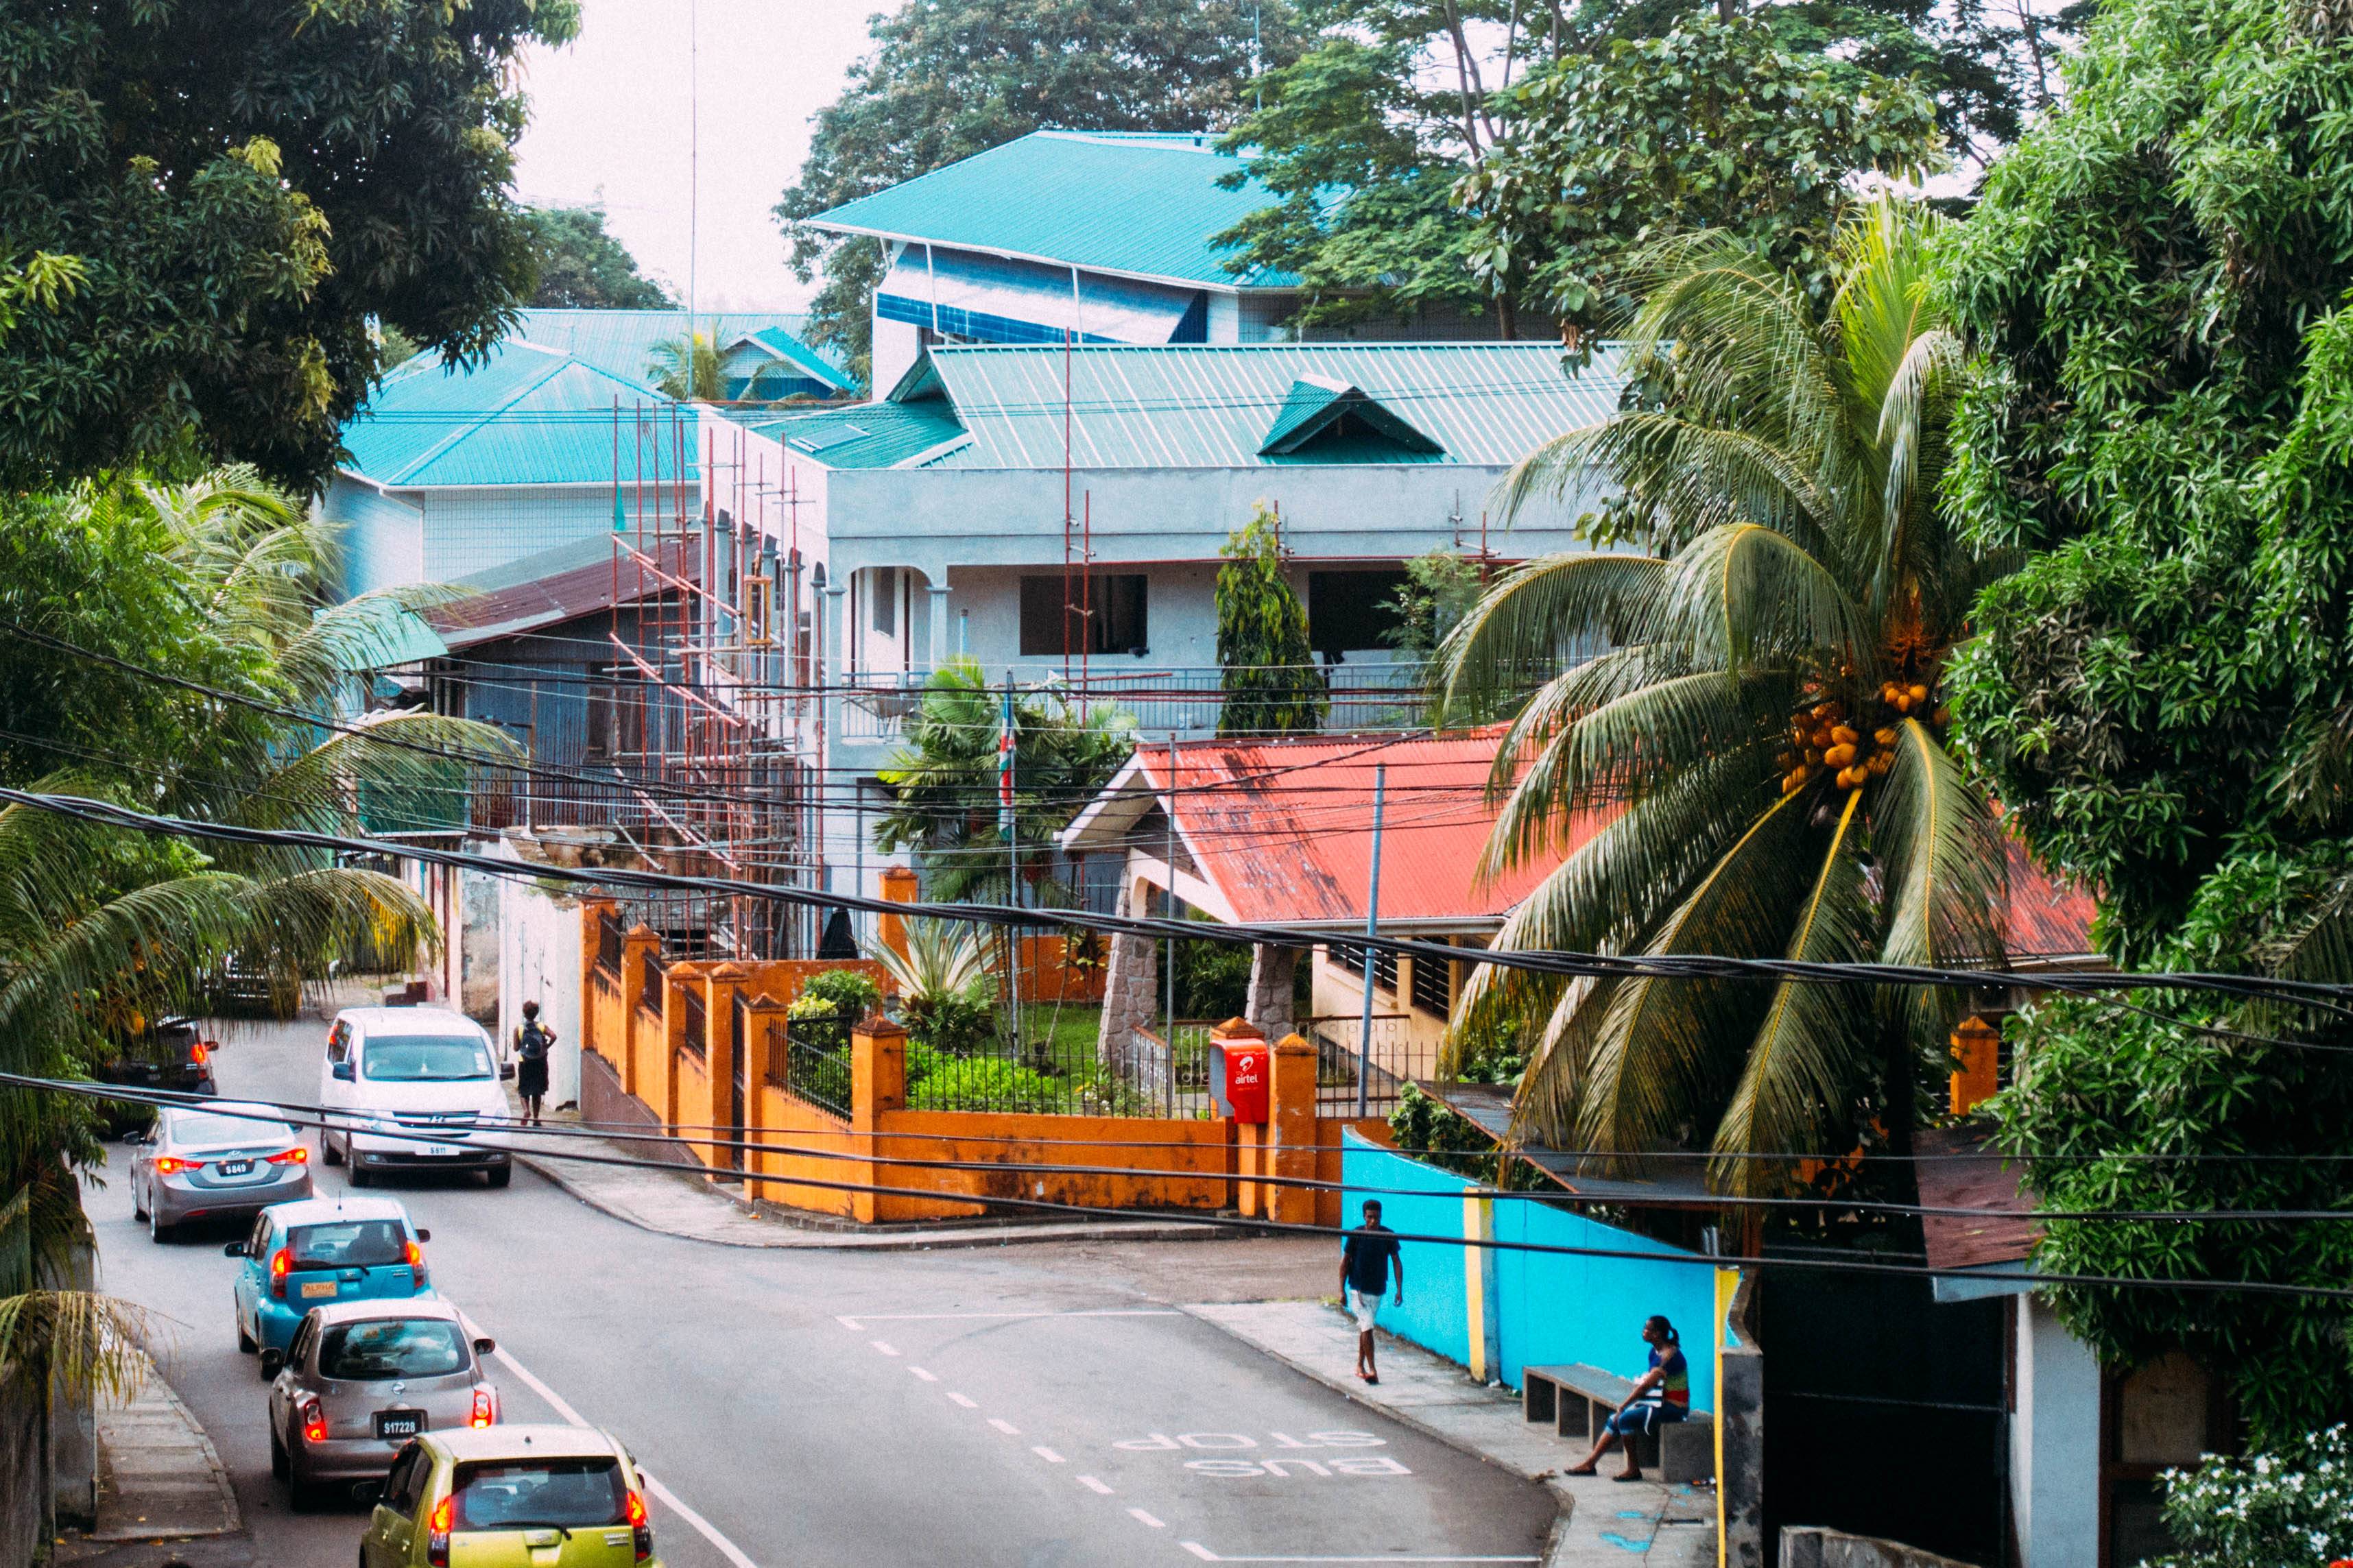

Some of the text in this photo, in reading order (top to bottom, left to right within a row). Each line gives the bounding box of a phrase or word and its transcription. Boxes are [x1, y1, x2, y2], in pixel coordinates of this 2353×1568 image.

[1235, 1074, 1258, 1085] airtel
[384, 1422, 416, 1434] S17228
[1112, 1431, 1387, 1450] STOP
[1183, 1457, 1412, 1477] BUS
